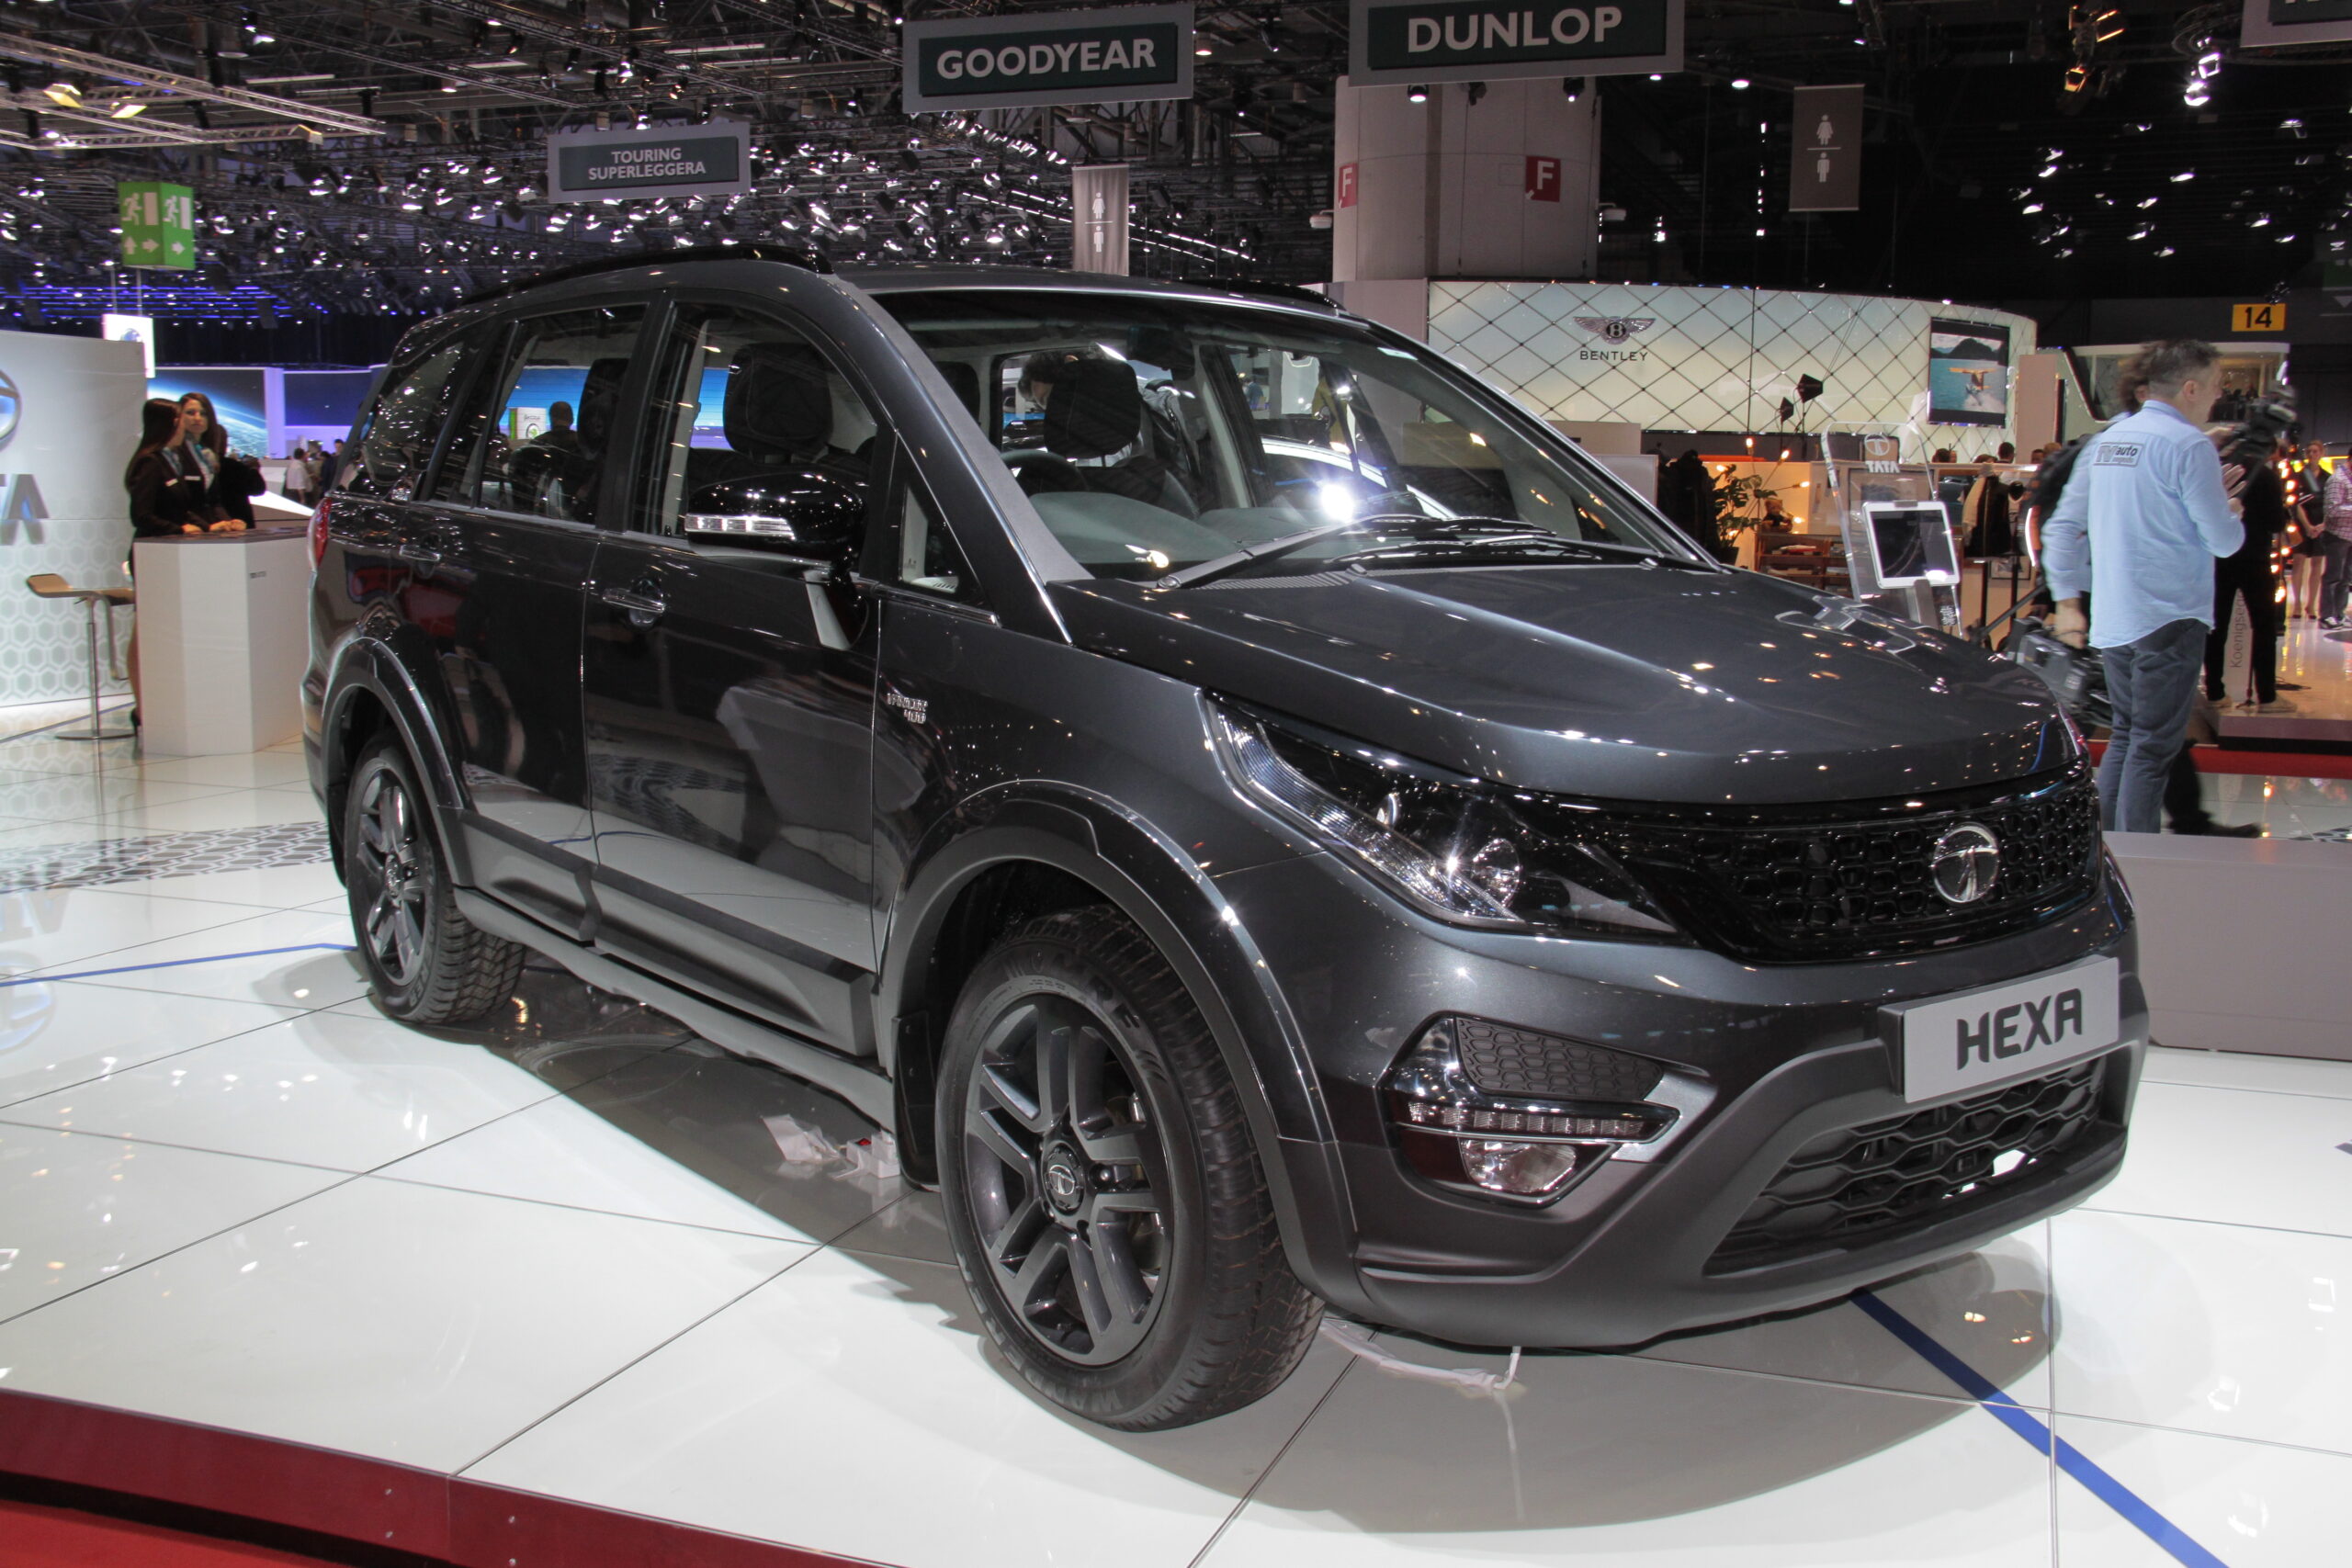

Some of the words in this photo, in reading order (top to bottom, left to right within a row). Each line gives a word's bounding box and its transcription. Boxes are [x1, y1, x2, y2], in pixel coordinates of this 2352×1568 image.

[1408, 6, 1623, 53] DUNLOP
[937, 38, 1156, 80] GOODYEAR
[611, 147, 683, 164] TOURING
[588, 159, 706, 182] SUPERLEGGERA
[1340, 165, 1353, 197] F
[1535, 160, 1555, 190] F
[2245, 306, 2272, 328] 14
[1580, 351, 1648, 361] BENTLEY
[2115, 445, 2139, 457] auto
[1865, 460, 1901, 473] TATA
[1957, 987, 2083, 1070] HEXA
